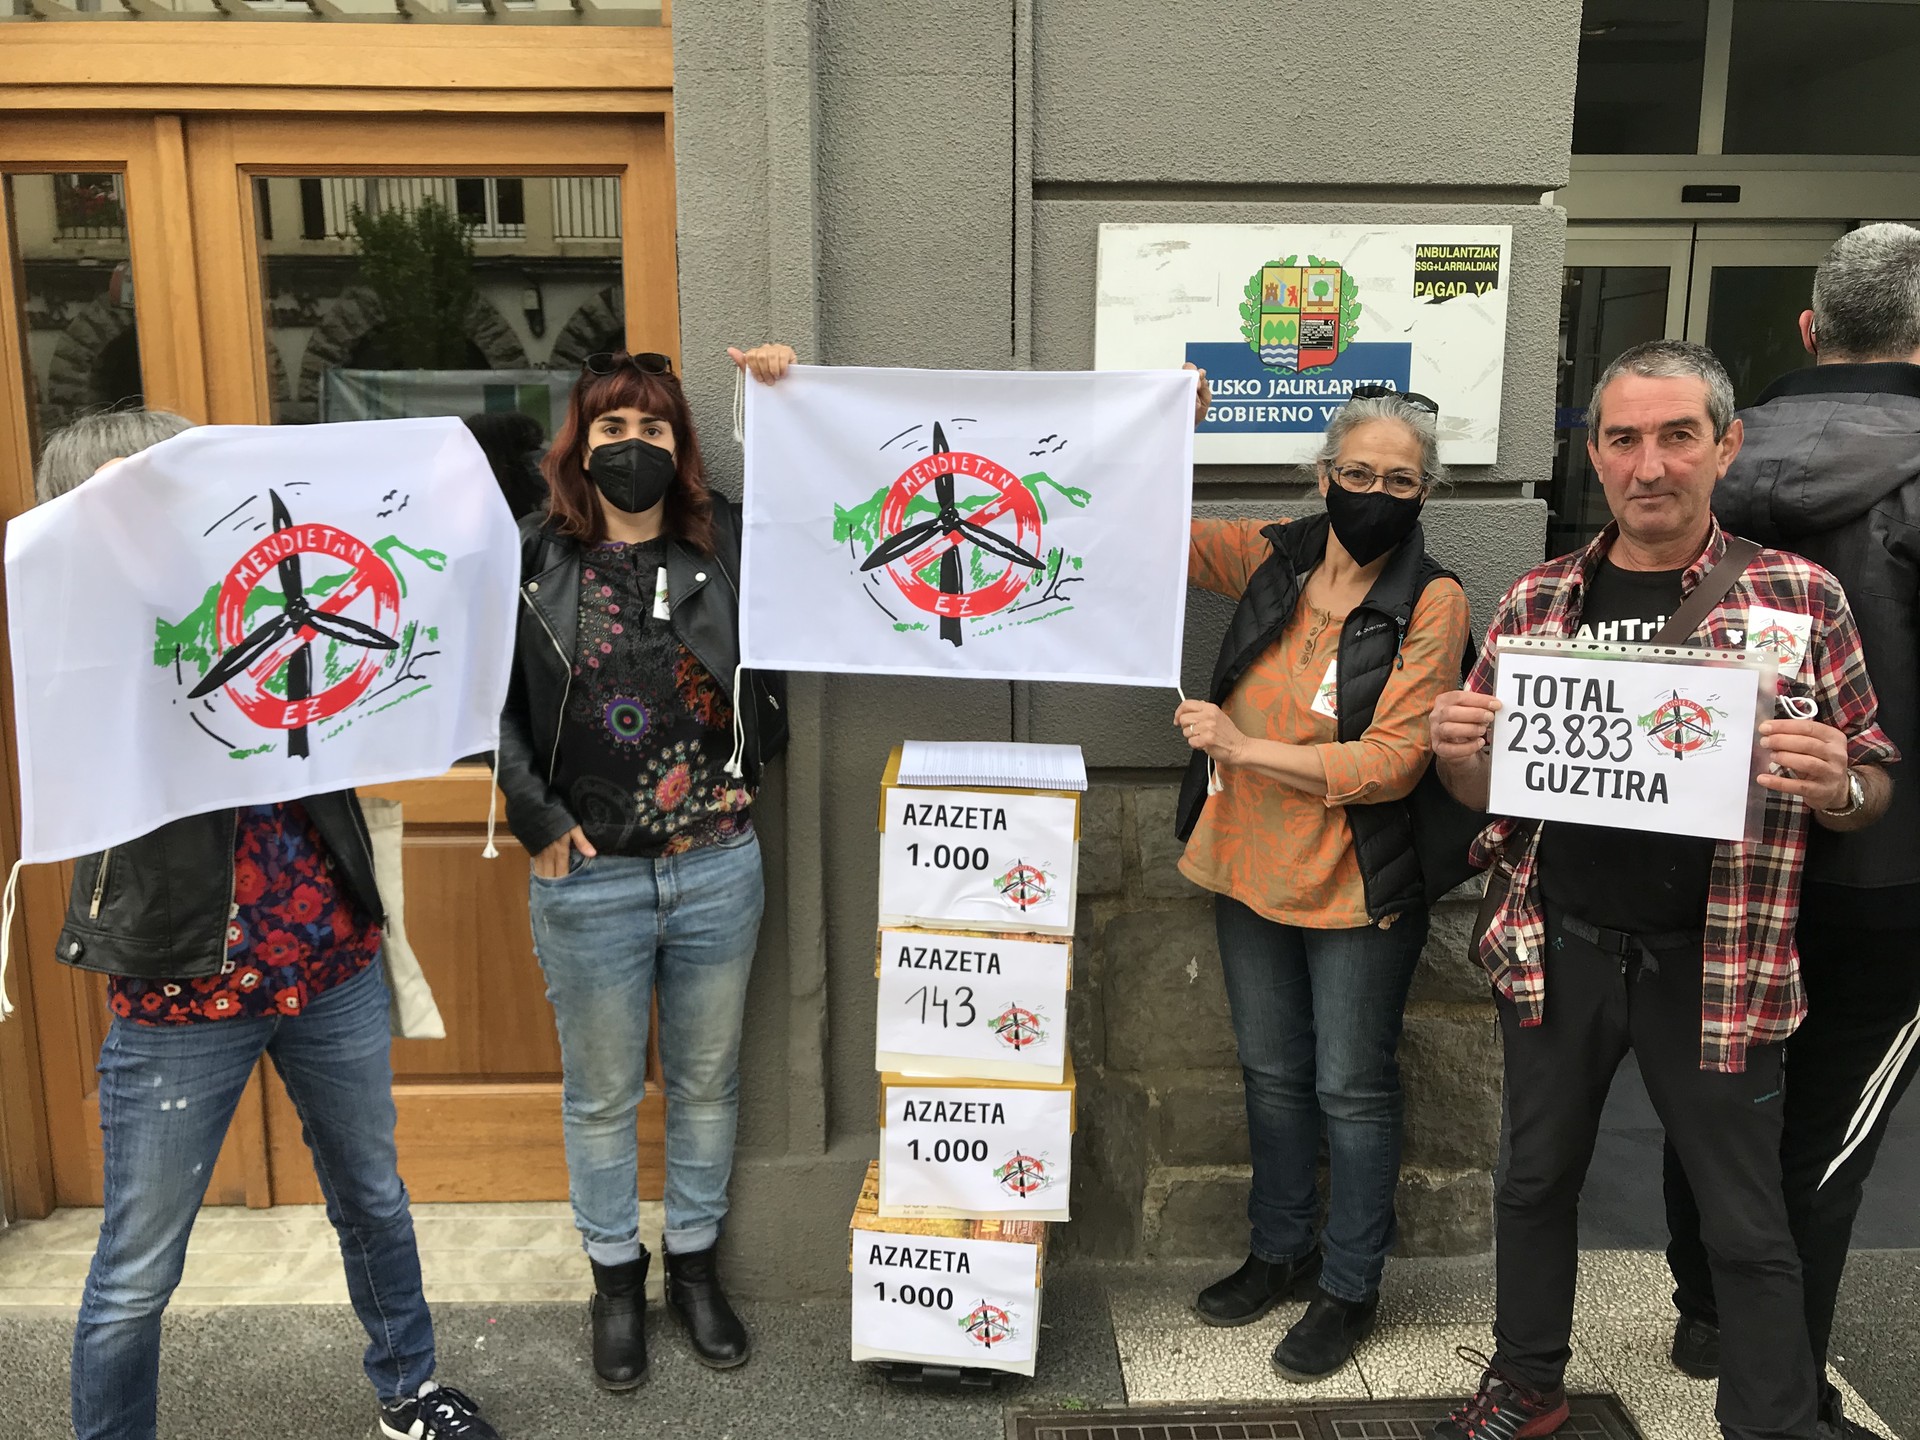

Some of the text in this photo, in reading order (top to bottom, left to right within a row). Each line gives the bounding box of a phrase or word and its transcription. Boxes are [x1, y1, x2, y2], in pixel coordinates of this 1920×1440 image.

[1416, 246, 1499, 258] ANBULANTZIAK
[1415, 261, 1498, 271] SSG+LARRIALDIAK
[1415, 281, 1494, 297] PAGAD YA
[1208, 379, 1262, 395] USKO
[1205, 406, 1313, 422] GOBIERNO
[901, 456, 1013, 496] MENDIETAN
[235, 528, 364, 590] MENDIETAN
[935, 596, 973, 615] EZ
[1575, 615, 1671, 641] AHTri
[1512, 673, 1624, 714] TOTAL
[281, 698, 321, 725] EZ
[1507, 711, 1633, 763] 23.833
[1525, 761, 1669, 804] GUZTIRA
[903, 803, 1007, 831] AZAZETA
[906, 843, 989, 870] 1.000
[898, 946, 1001, 975] AZAZETA
[905, 985, 976, 1028] 143
[903, 1100, 1005, 1125] AZAZETA
[907, 1139, 988, 1163] 1.000
[869, 1244, 970, 1274] AZAZETA
[873, 1281, 954, 1310] 1.000
